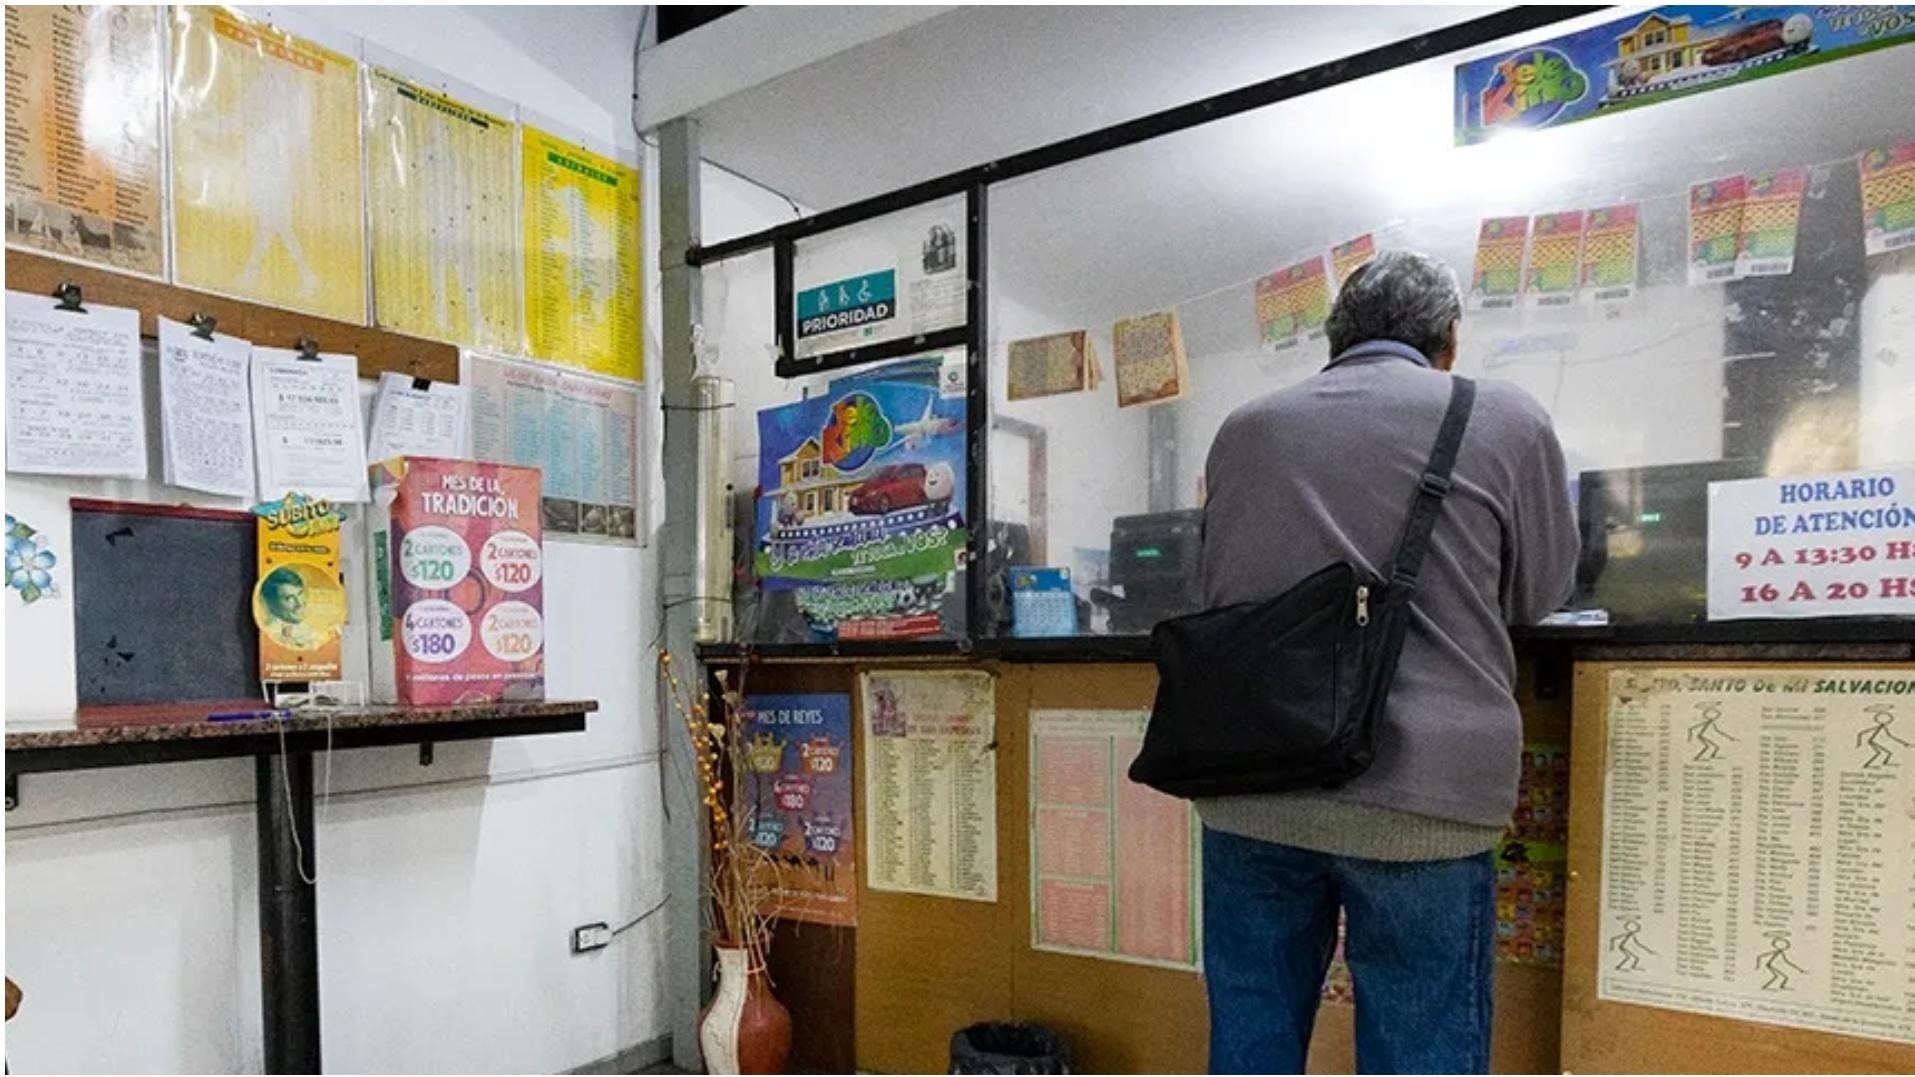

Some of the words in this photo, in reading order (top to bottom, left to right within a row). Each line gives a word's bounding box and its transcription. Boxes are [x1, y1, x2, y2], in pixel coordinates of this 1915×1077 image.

[802, 303, 888, 334] PRIORIDAD
[442, 475, 466, 490] MES
[469, 476, 485, 491] DE
[487, 478, 501, 492] LA
[1780, 477, 1895, 504] HORARIO
[422, 489, 519, 519] TRADICIÓN
[1755, 515, 1787, 535] DE
[1792, 503, 1915, 534] ATENCIÓN
[404, 539, 413, 557] 2
[488, 543, 497, 560] 2
[1735, 551, 1753, 570] 9
[1760, 547, 1784, 566] A
[1794, 545, 1877, 566] 13:30
[1886, 541, 1915, 560] H
[412, 560, 454, 580] $120
[495, 563, 532, 584] $120
[1741, 583, 1779, 603] 16
[1788, 580, 1816, 601] A
[1826, 582, 1869, 600] 20
[406, 614, 414, 631] 4
[488, 615, 497, 632] 2
[412, 634, 455, 654] $180
[496, 634, 532, 653] $120
